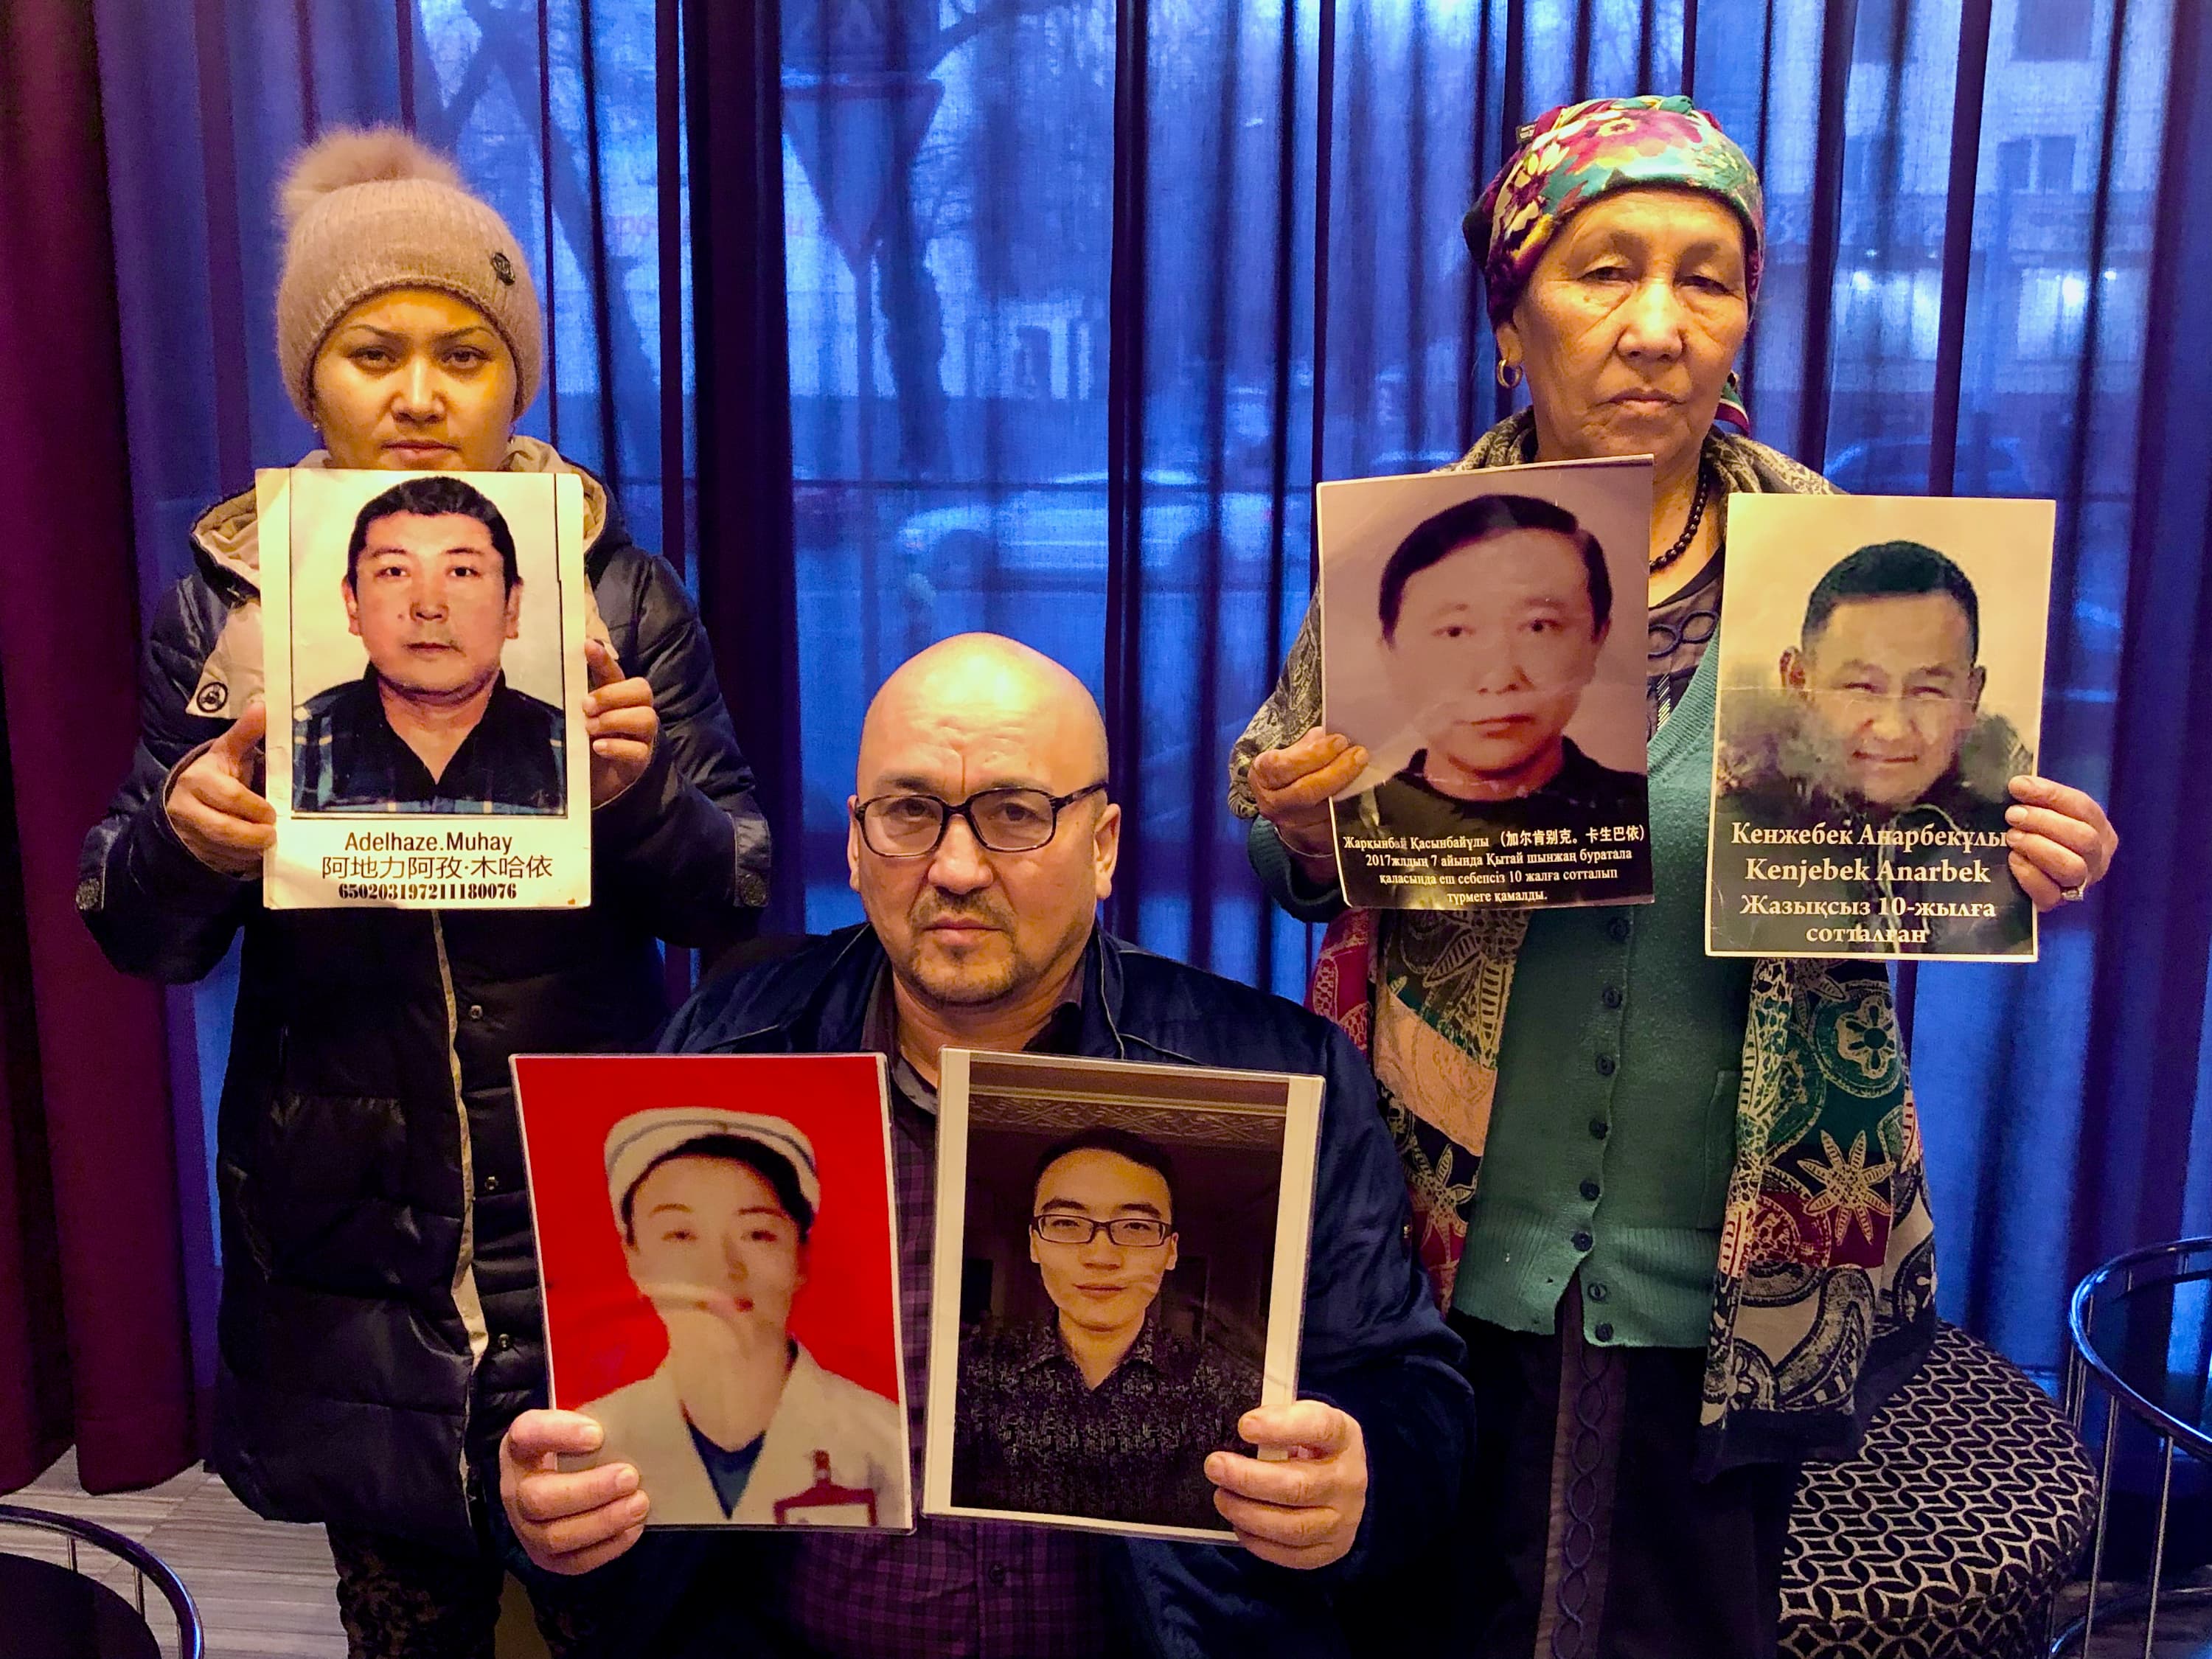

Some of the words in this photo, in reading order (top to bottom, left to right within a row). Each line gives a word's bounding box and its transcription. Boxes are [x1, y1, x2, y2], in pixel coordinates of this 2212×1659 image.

[344, 832, 512, 855] Adelhaze.Muhay
[1731, 821, 1853, 845] Кенжебек
[322, 855, 553, 879] 阿地力阿孜·木哈依
[1430, 855, 1437, 866] 7
[1441, 854, 1484, 867] айында
[1486, 852, 1523, 867] Қытай
[1579, 848, 1632, 864] буратала
[1439, 875, 1455, 884] еш
[1509, 870, 1522, 883] 10
[1563, 869, 1618, 880] сотталып
[1745, 858, 1869, 887] Kenjebek
[1877, 860, 1991, 883] Anarbek
[338, 883, 517, 900] 650203197211180076
[1739, 894, 1871, 919] Жазықсыз
[1878, 897, 1997, 917] 10-жылға
[1806, 927, 1927, 943] сотталған
